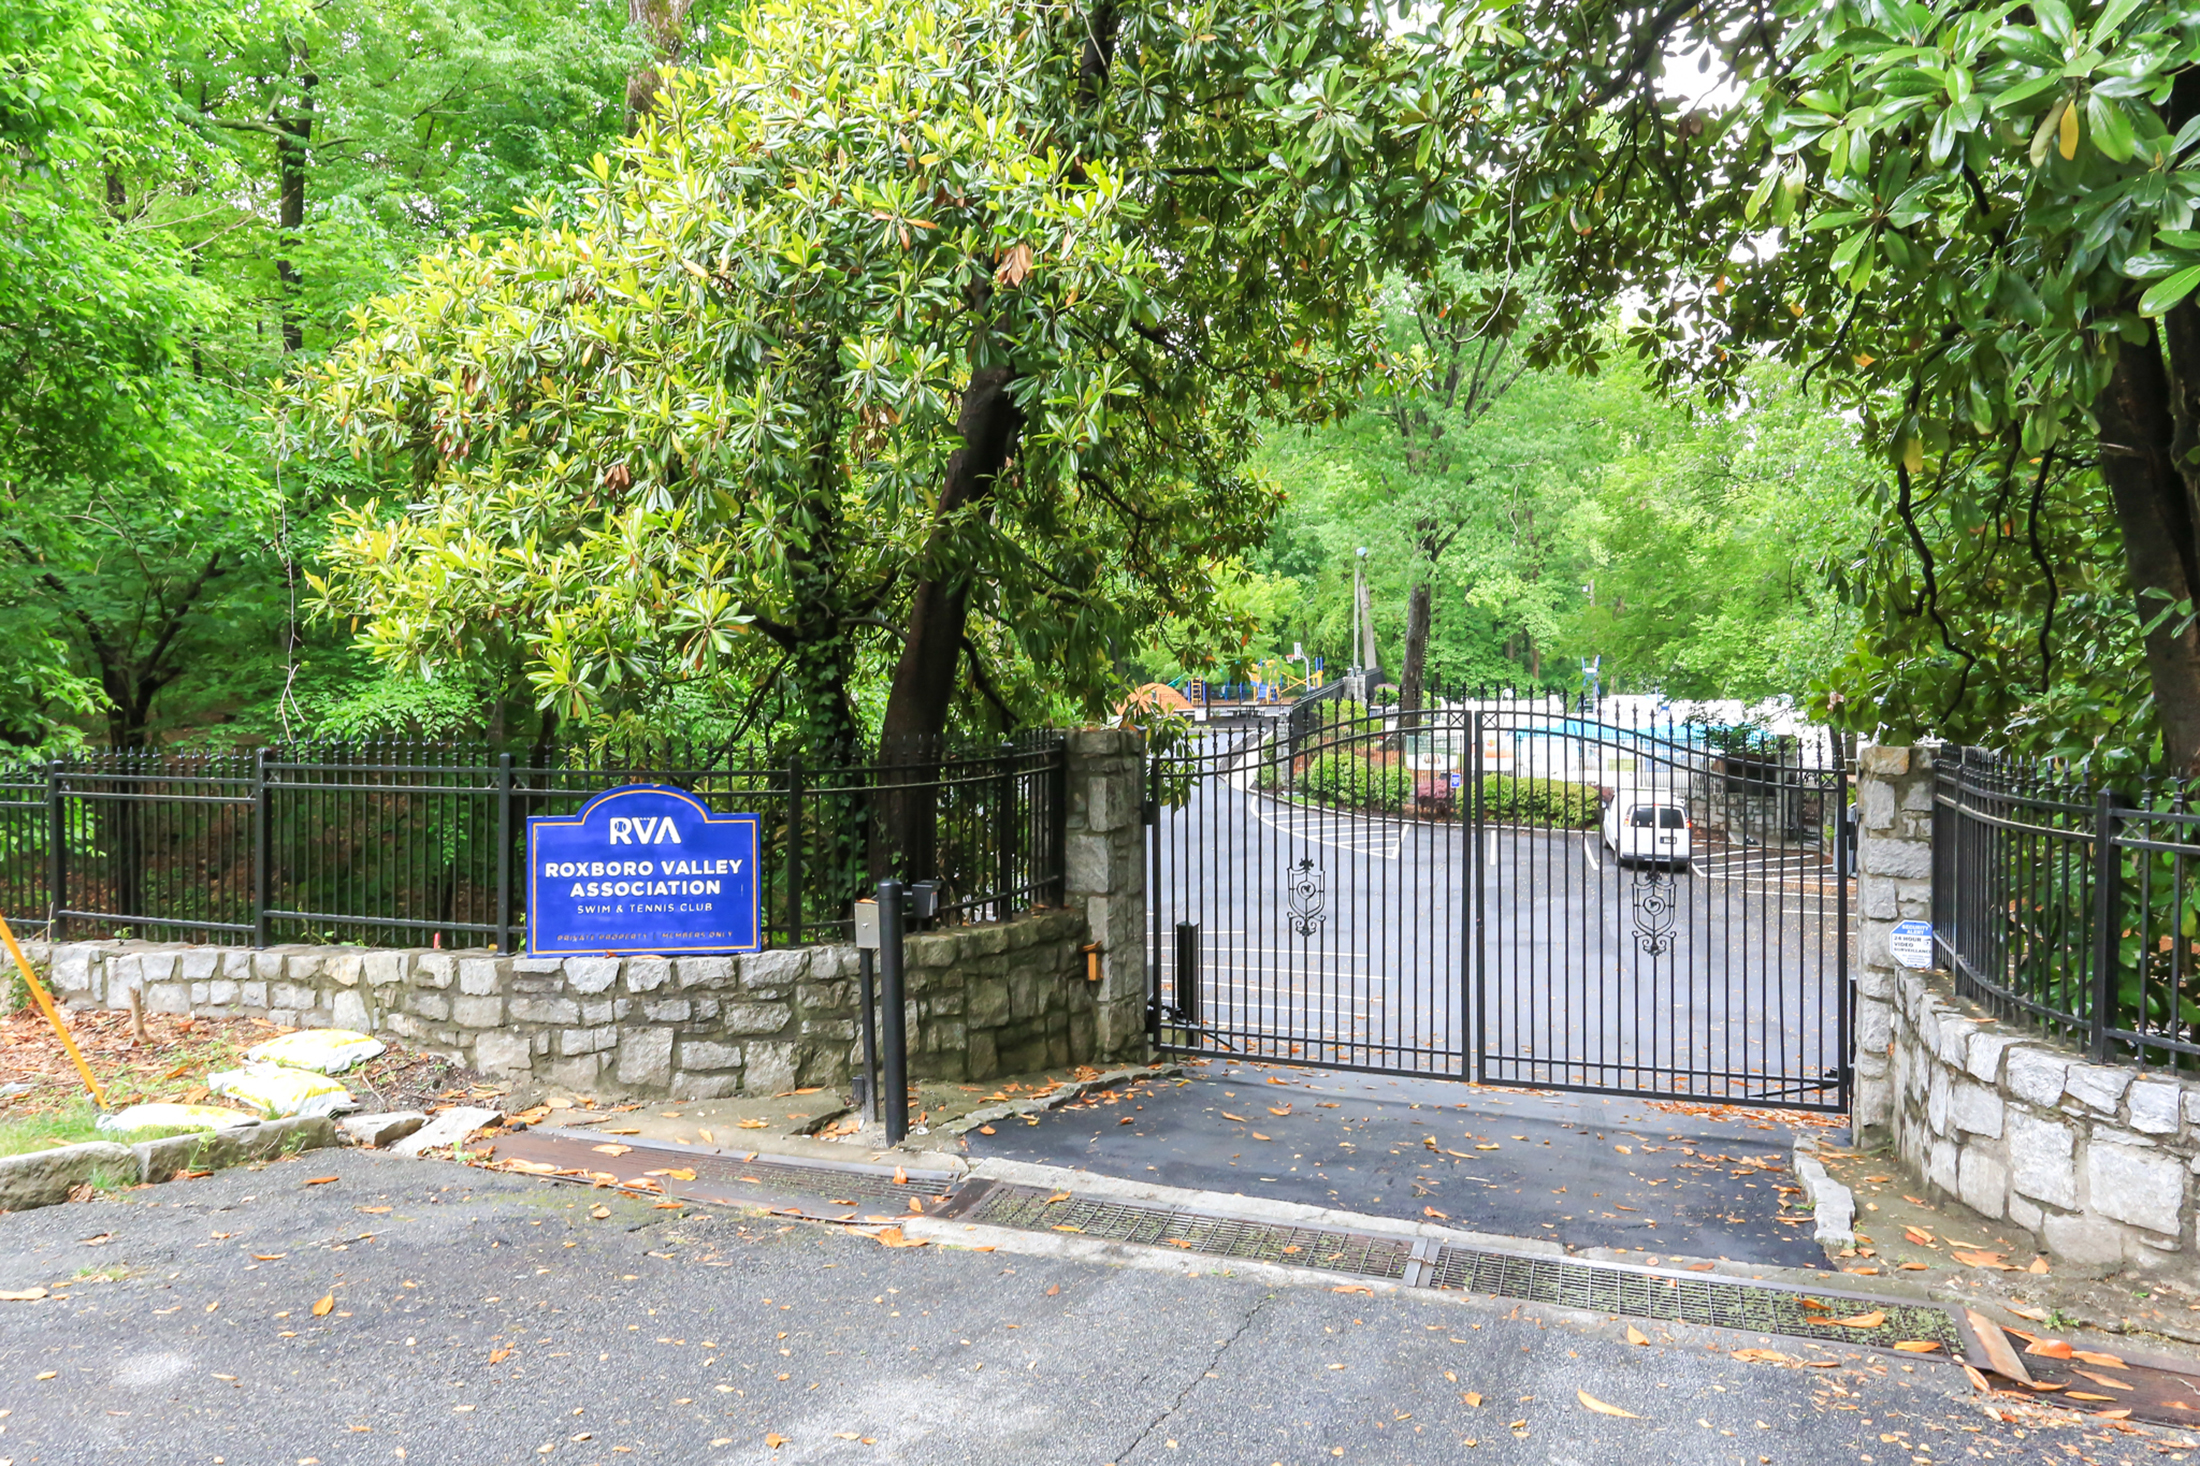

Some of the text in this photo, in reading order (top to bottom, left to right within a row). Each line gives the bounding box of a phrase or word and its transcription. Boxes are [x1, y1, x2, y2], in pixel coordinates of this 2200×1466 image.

[609, 816, 682, 845] RVA
[545, 859, 743, 878] ROXBORO VALLEY
[570, 879, 721, 898] ASSOCIATION
[577, 902, 713, 914] SWIM & TENNIS CLUB
[557, 934, 595, 942] PRIVATE
